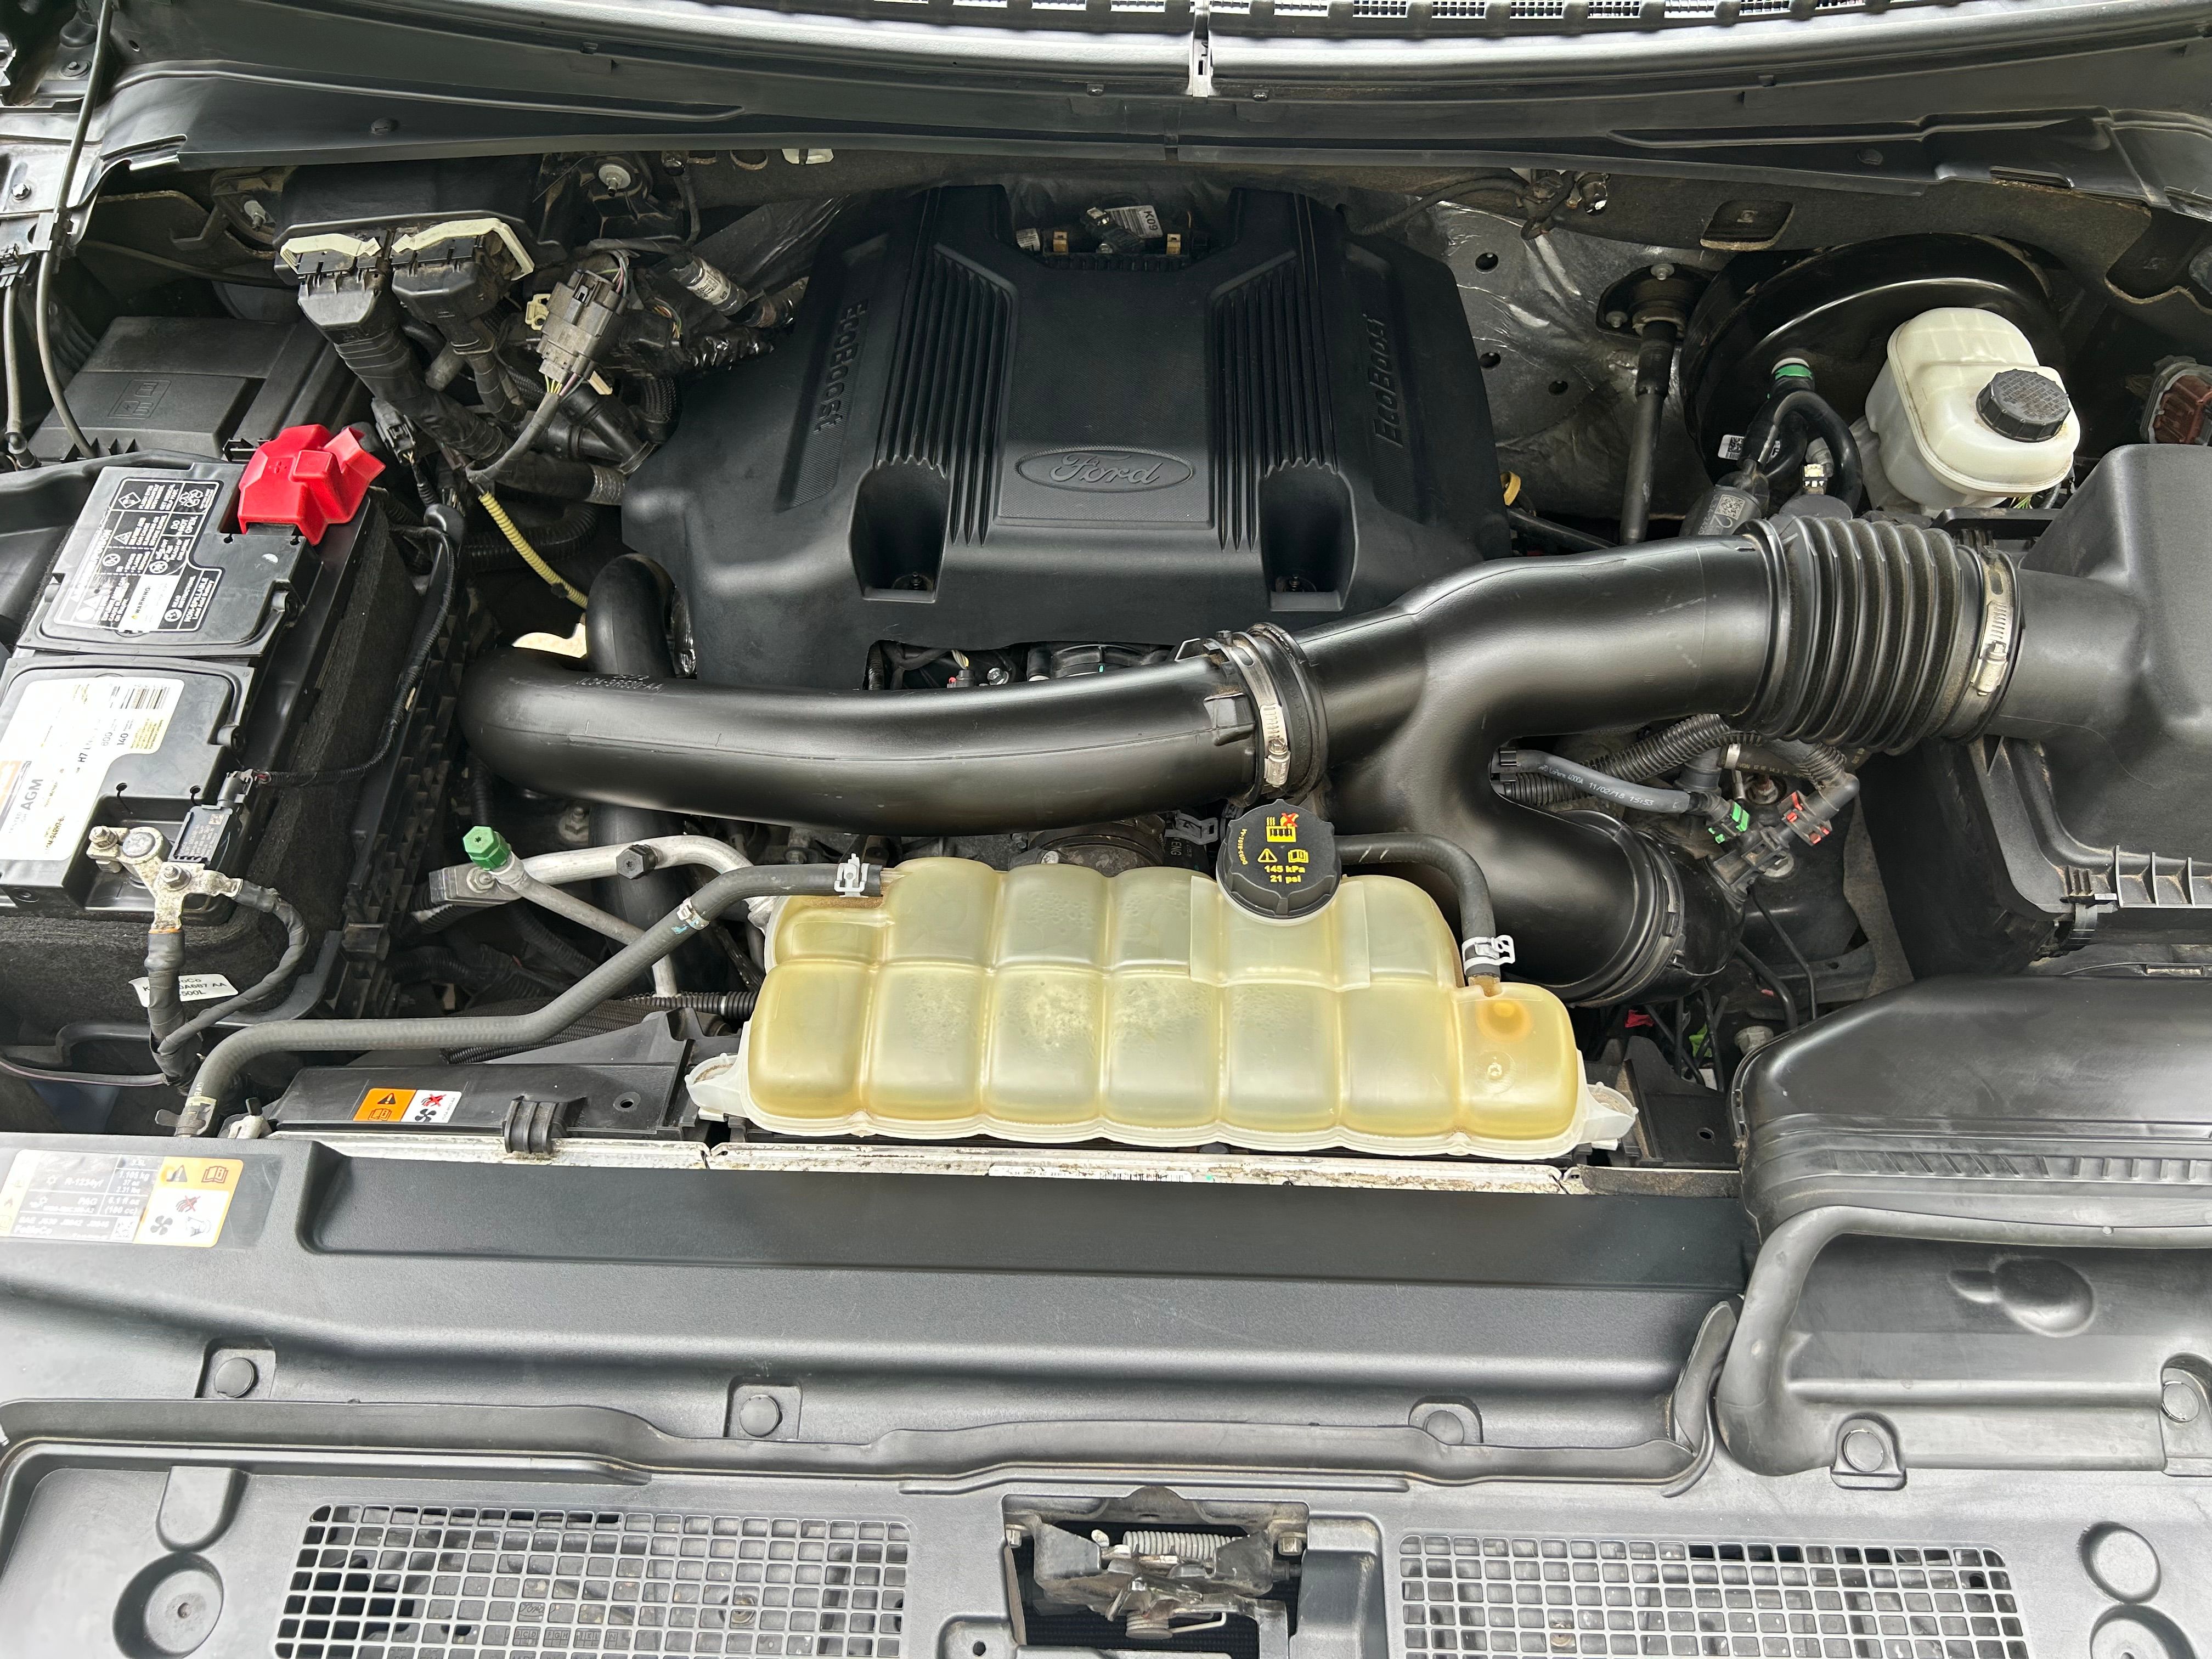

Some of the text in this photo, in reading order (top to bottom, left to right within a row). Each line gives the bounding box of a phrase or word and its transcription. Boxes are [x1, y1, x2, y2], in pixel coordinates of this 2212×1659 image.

[1143, 211, 1158, 230] K09
[813, 300, 868, 433] EcoBoost
[1363, 314, 1403, 448] EcoBoost
[1050, 453, 1164, 484] Ford
[169, 520, 181, 529] DO
[176, 518, 189, 531] NOT
[183, 515, 199, 533] OPEN.
[171, 595, 182, 607] READ
[182, 577, 210, 622] NON-SPILLABLE
[99, 731, 114, 746] 800
[115, 732, 130, 746] 140
[76, 752, 89, 762] H7
[1567, 774, 1584, 785] 4000A
[18, 778, 44, 810] AGM
[1589, 782, 1655, 806] 11/02/18 15:53
[1170, 842, 1182, 856] ENG
[1285, 875, 1301, 884] psi
[64, 1177, 104, 1189] R-1234yf
[139, 1172, 150, 1181] kg
[78, 1197, 98, 1205] PAG
[124, 1207, 138, 1216] cc)
[14, 1224, 53, 1234] FoMoCo
